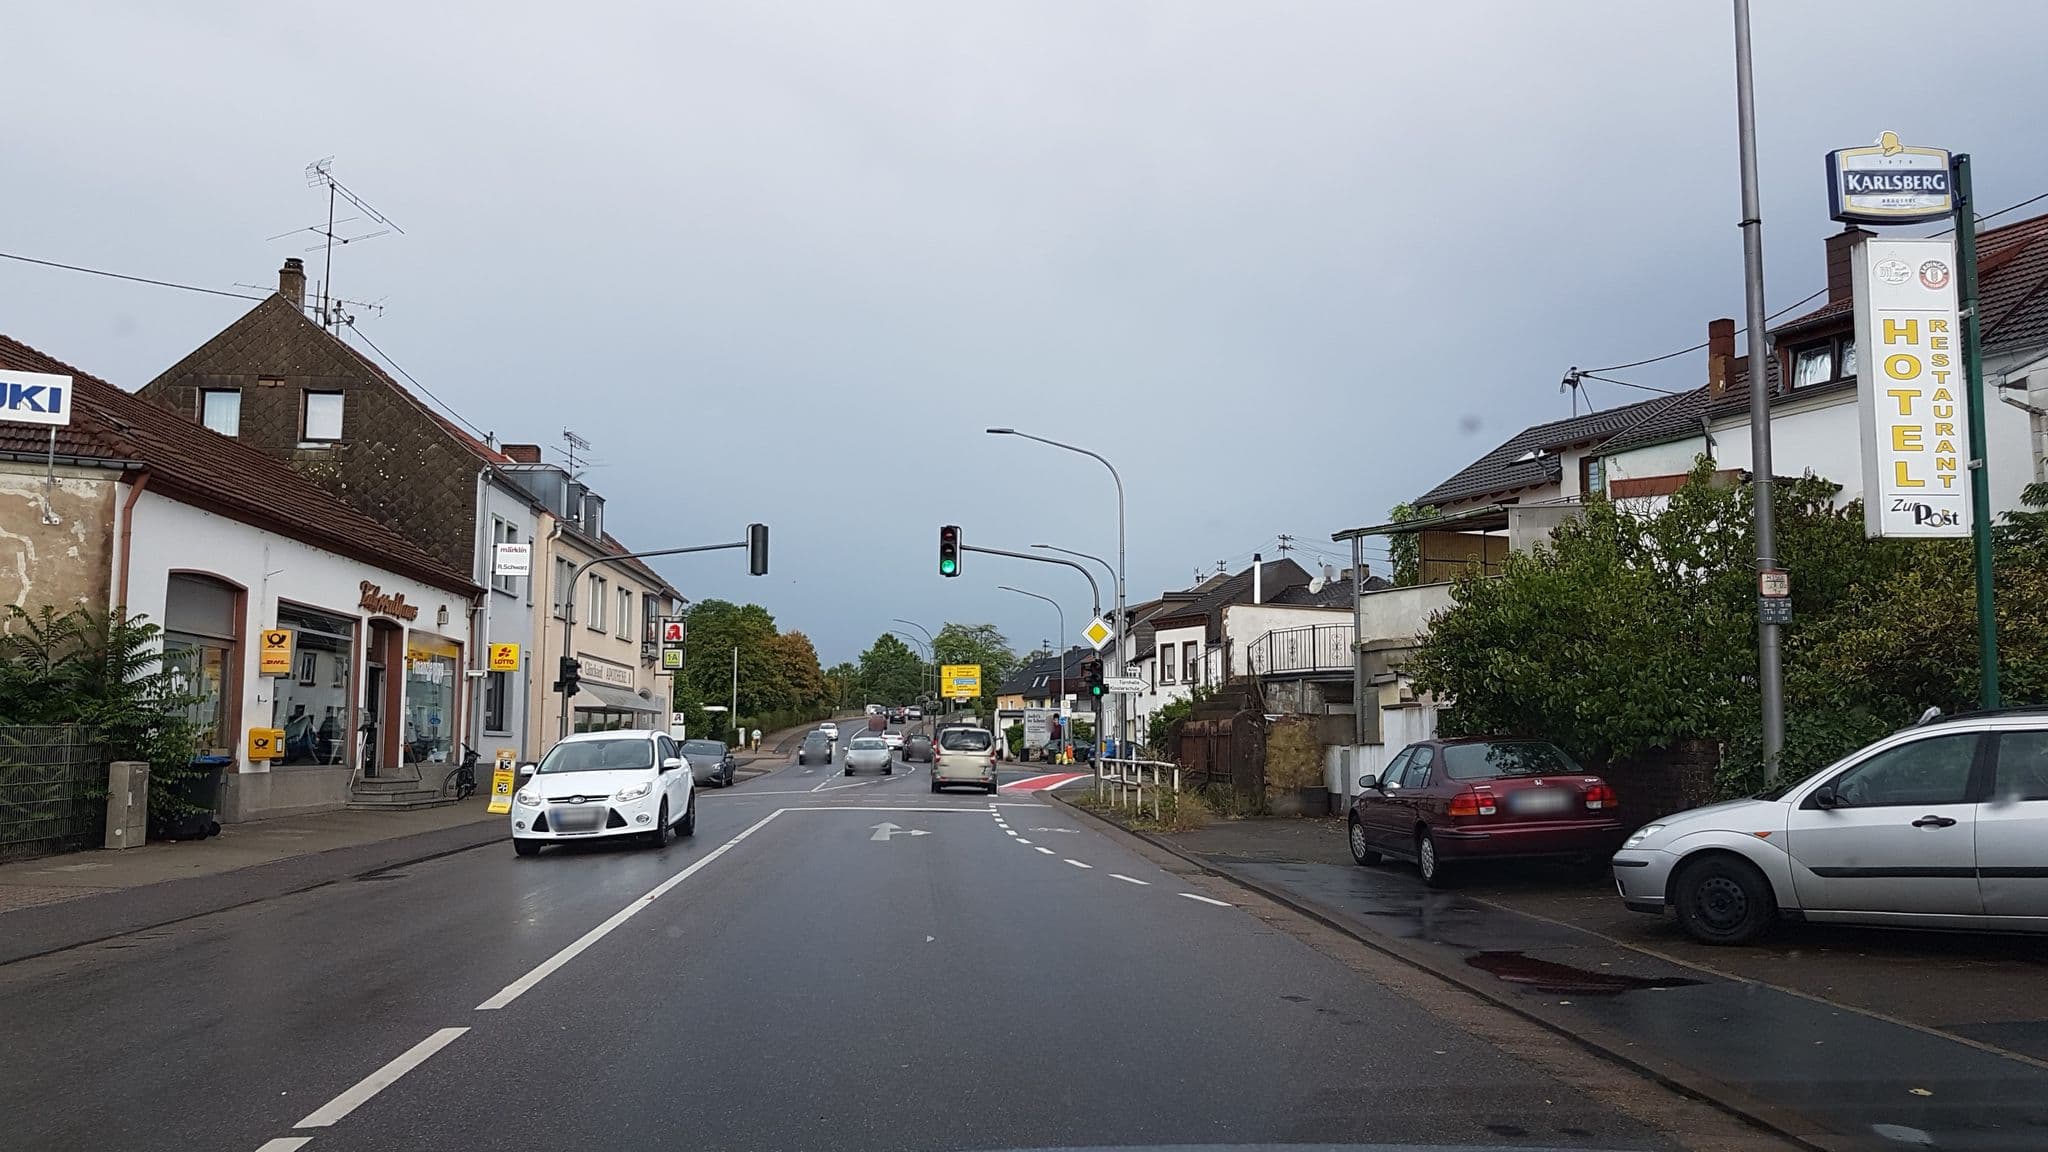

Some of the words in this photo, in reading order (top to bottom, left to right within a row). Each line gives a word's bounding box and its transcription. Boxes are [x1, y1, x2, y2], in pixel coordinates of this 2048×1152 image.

[1847, 173, 1946, 191] KARLSBERG
[0, 382, 62, 413] KI
[1882, 318, 1926, 488] HOTEL
[1928, 319, 1957, 489] RESTAURANT
[1890, 499, 1921, 512] Zur
[1914, 504, 1960, 527] Post
[497, 783, 508, 793] 28
